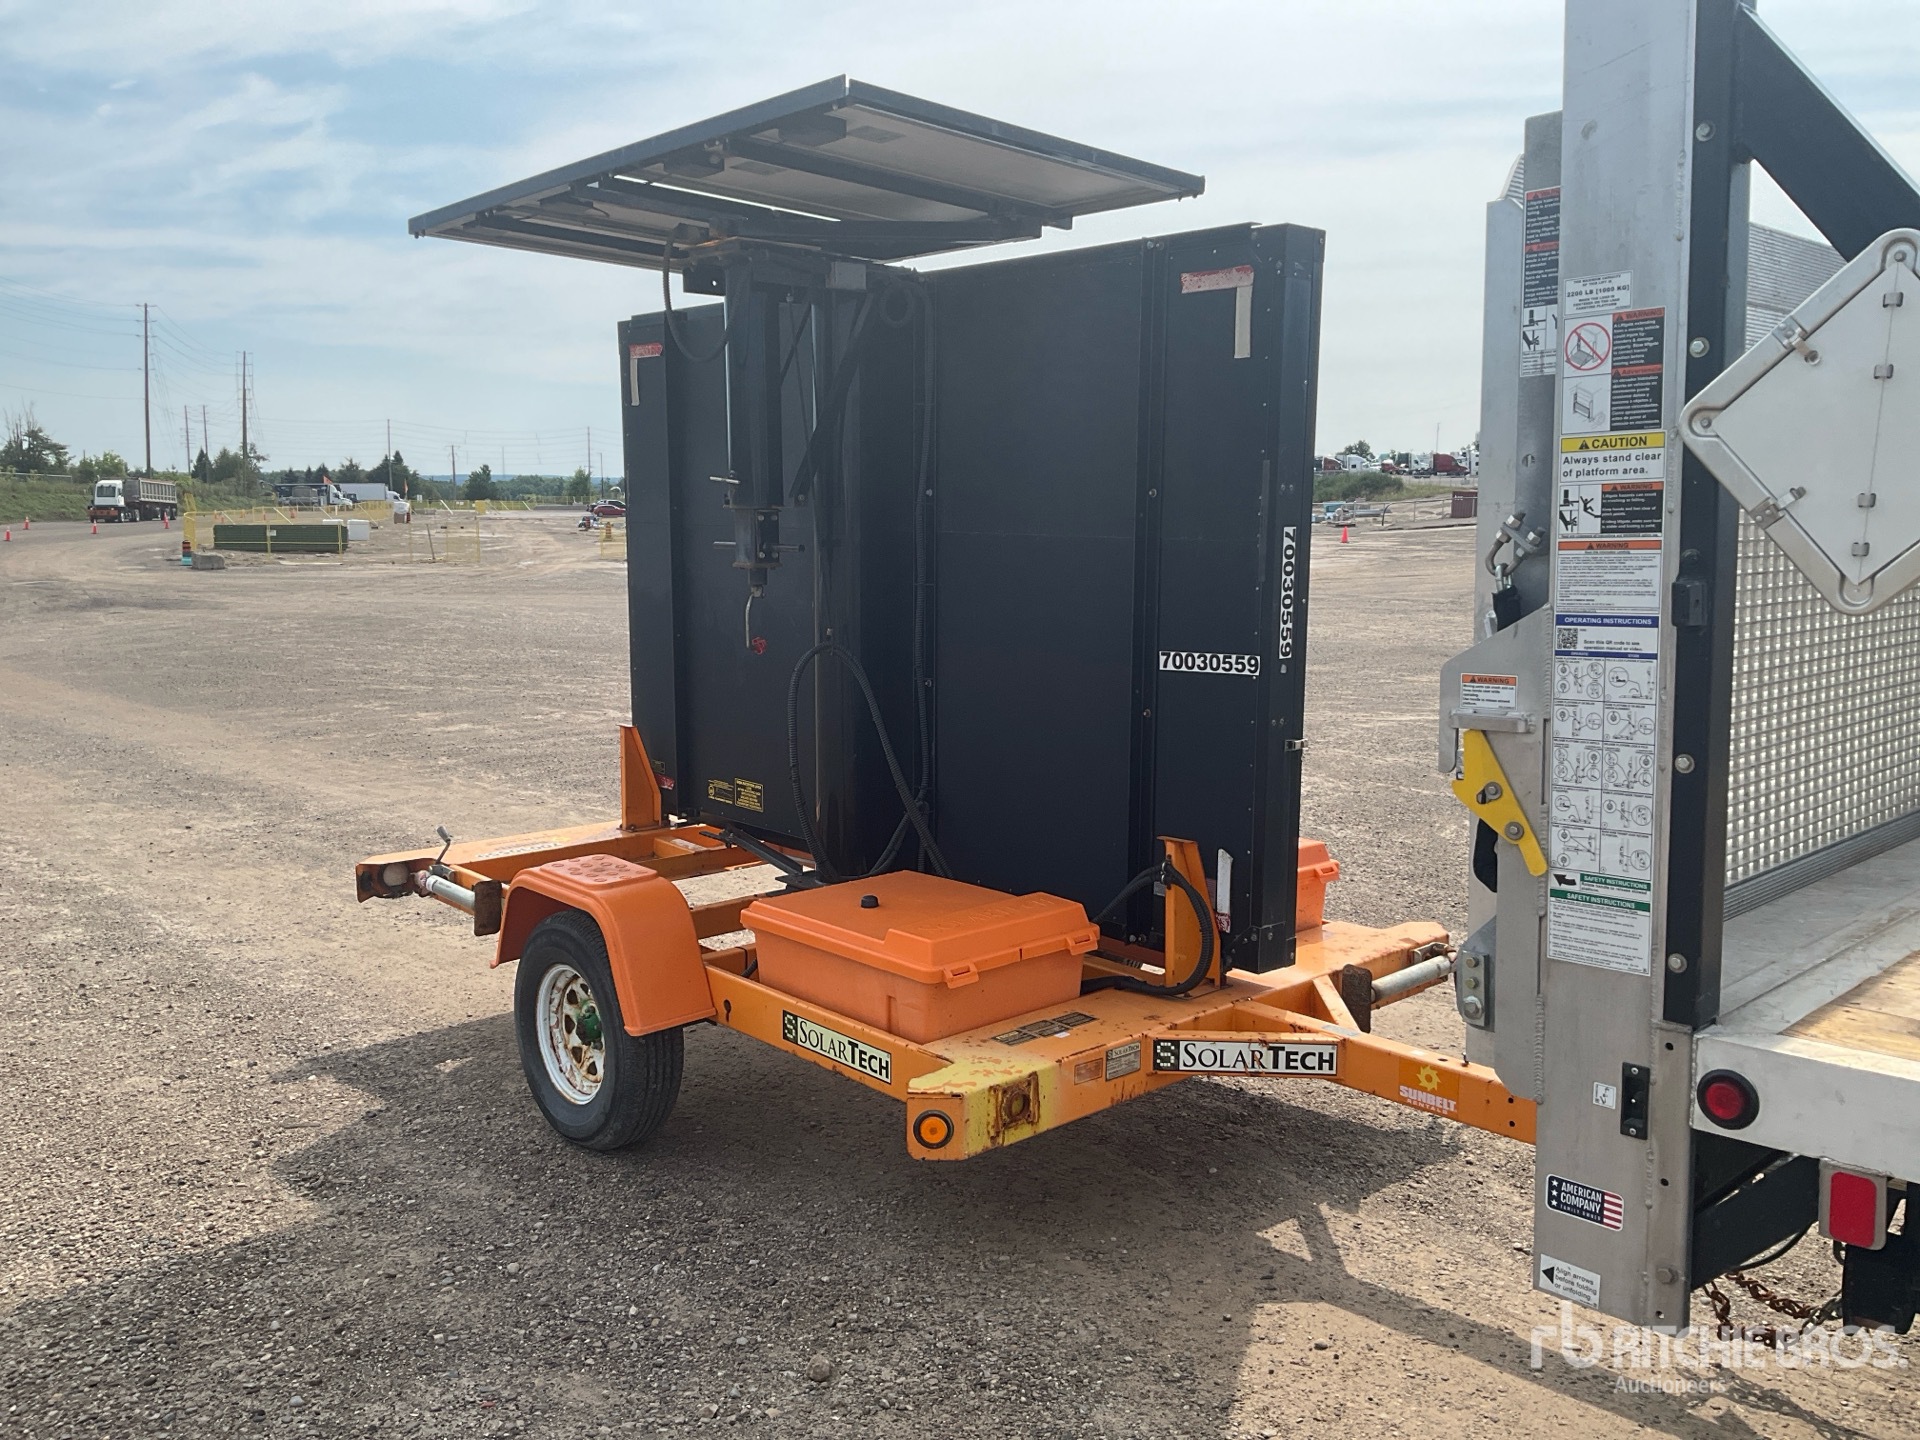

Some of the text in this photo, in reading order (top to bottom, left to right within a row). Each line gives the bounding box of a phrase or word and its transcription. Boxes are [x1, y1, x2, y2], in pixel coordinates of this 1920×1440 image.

[1596, 286, 1614, 294] [1000
[1592, 436, 1647, 448] CAUTION
[1563, 456, 1598, 465] Always
[1603, 453, 1631, 462] stand
[1563, 469, 1572, 477] of
[1576, 468, 1618, 478] platform
[1280, 528, 1296, 657] 70030559
[1160, 652, 1259, 674] 70030559
[1606, 880, 1648, 890] INSTRUCTIONS
[1566, 893, 1589, 901] SAFETY
[1590, 896, 1635, 908] INSTRUCTIONS
[800, 1020, 889, 1079] SOLARTECH
[1182, 1043, 1334, 1071] SOLARTECH
[1400, 1085, 1456, 1111] SUNBELT
[1407, 1099, 1447, 1114] RENTALS
[1562, 1182, 1602, 1202] AMERICAN
[1560, 1204, 1580, 1214] FAMILY
[1561, 1192, 1601, 1213] COMPANY
[1556, 1267, 1594, 1285] Align arrows
[1555, 1274, 1597, 1295] before folding
[1563, 1287, 1591, 1301] unfolding
